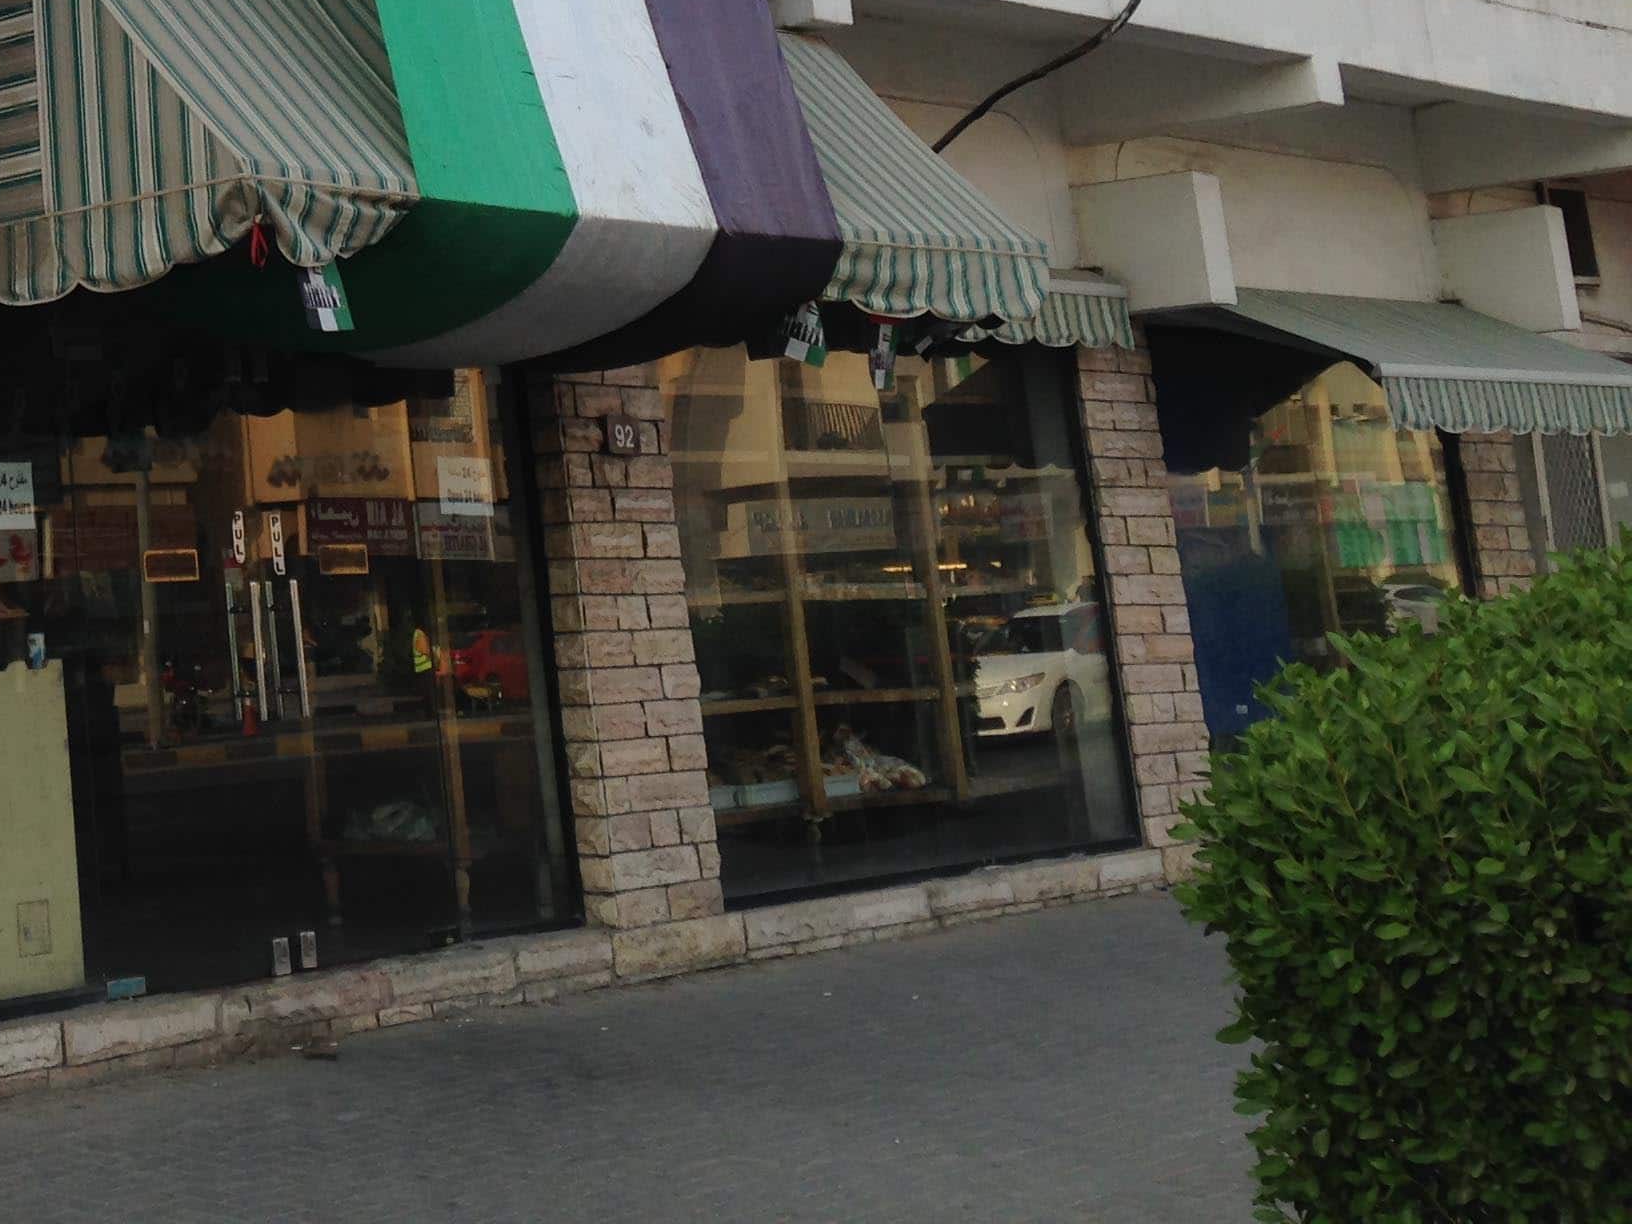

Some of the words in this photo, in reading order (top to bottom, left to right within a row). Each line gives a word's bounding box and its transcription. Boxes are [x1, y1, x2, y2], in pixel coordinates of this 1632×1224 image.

[614, 423, 635, 449] 92
[9, 498, 32, 516] hours
[271, 516, 284, 573] PULL
